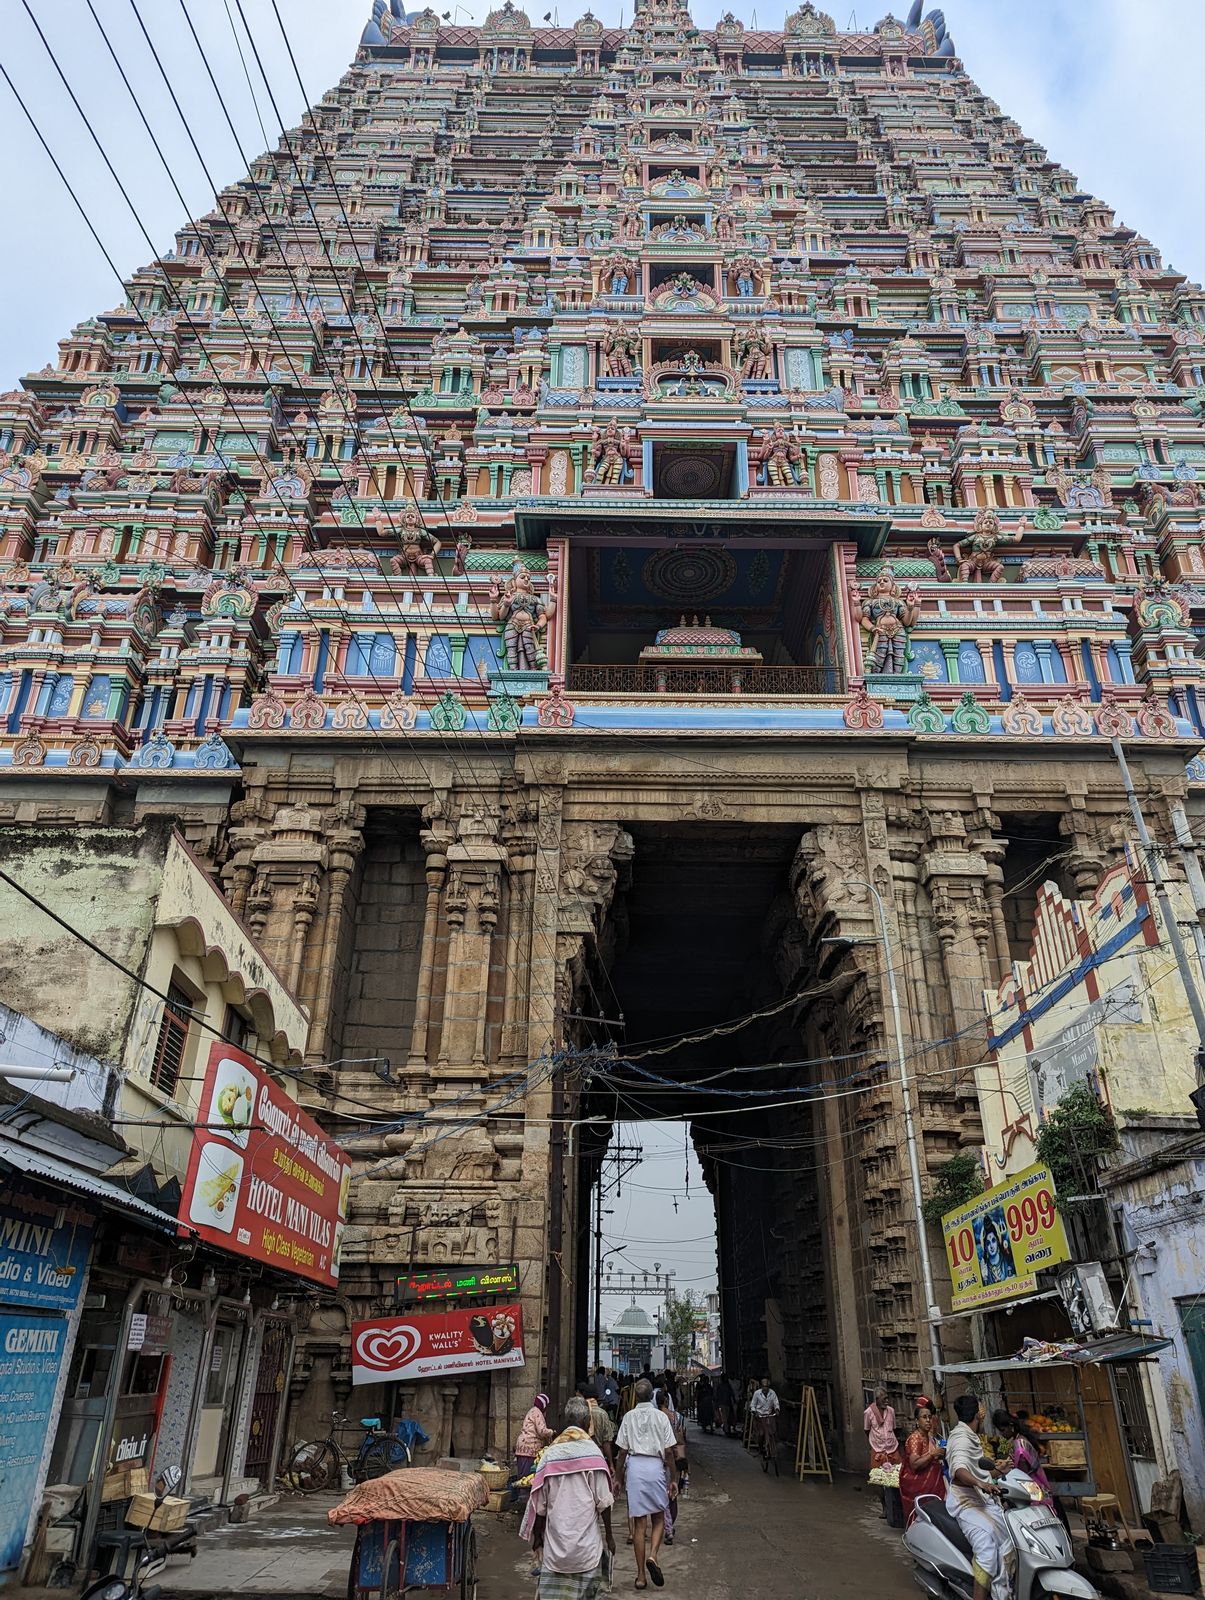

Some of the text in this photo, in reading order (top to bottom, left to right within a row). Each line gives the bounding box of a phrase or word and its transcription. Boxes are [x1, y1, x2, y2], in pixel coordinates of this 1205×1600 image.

[247, 1174, 331, 1249] HOTEL MANI VILAS
[1007, 1189, 1055, 1242] 999
[0, 1216, 54, 1258] MINI
[261, 1226, 275, 1258] High
[275, 1233, 291, 1258] Class
[290, 1240, 314, 1266] Vegetarian
[948, 1228, 974, 1268] 10
[1024, 1246, 1053, 1264] வரை
[23, 1266, 33, 1283] &
[37, 1261, 72, 1288] Video
[456, 1276, 476, 1288] மணி
[480, 1273, 512, 1286] விலாஸ்
[957, 1273, 978, 1291] முதல்
[5, 1328, 59, 1354] GEMINI
[428, 1330, 464, 1341] KWALITY
[15, 1358, 36, 1375] Studio
[41, 1358, 58, 1374] Video
[493, 1356, 522, 1365] MANIVILAS
[10, 1390, 35, 1403] Coverage
